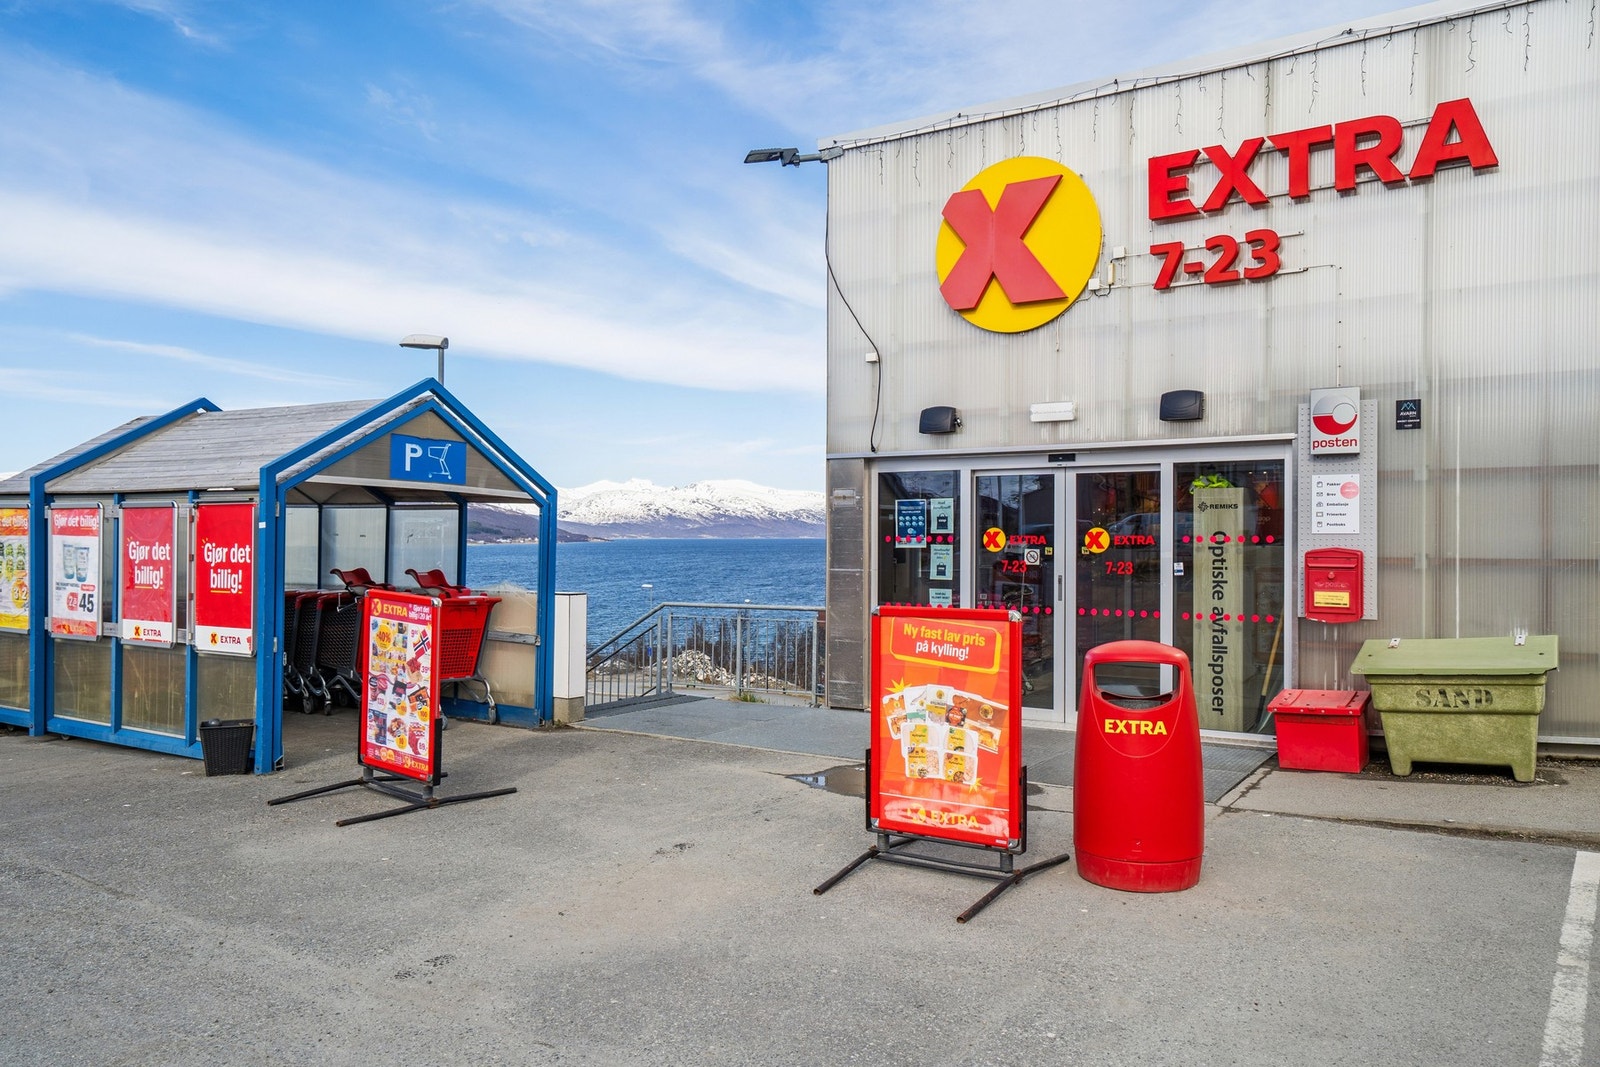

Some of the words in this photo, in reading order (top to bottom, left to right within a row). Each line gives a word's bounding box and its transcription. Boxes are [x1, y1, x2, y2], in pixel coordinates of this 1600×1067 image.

[1148, 97, 1499, 222] EXTRA
[1150, 228, 1282, 292] 7-23
[1312, 437, 1358, 450] posten
[405, 443, 423, 472] P
[53, 514, 67, 528] Gjør
[67, 515, 79, 527] det
[1009, 535, 1047, 544] EXTRA
[1114, 535, 1155, 545] EXTRA
[128, 541, 150, 564] Gjør
[152, 542, 170, 560] det
[203, 543, 228, 566] Gjør
[230, 544, 251, 563] det
[1001, 560, 1027, 572] 7-23
[1105, 561, 1133, 574] 7-23
[1208, 530, 1228, 601] Optiske
[134, 566, 164, 589] billig!
[210, 569, 243, 594] billig!
[79, 593, 94, 613] 45
[383, 604, 408, 617] EXTRA
[143, 628, 162, 637] EXTRA
[220, 635, 241, 645] EXTRA
[903, 623, 918, 639] Ny
[920, 626, 942, 640] fast
[943, 629, 960, 643] lav
[962, 633, 986, 647] pris
[916, 640, 929, 654] på
[930, 641, 970, 661] kylling!
[1208, 606, 1228, 716] avfallsposer
[1415, 688, 1494, 709] SAND
[1104, 718, 1168, 736] EXTRA
[930, 809, 979, 828] EXTRA
